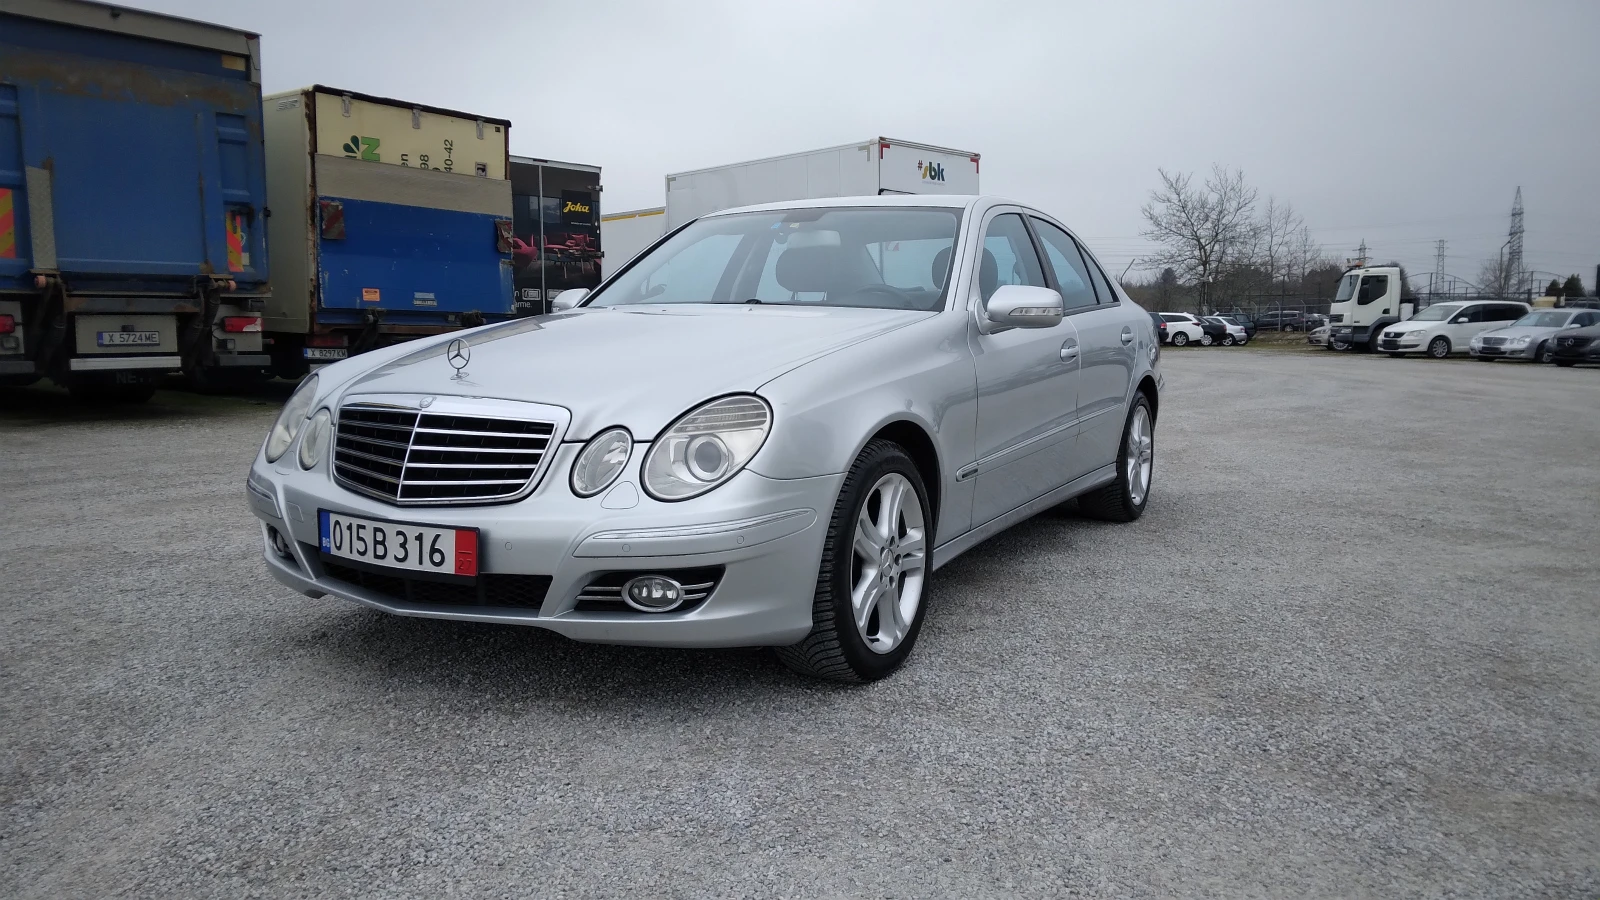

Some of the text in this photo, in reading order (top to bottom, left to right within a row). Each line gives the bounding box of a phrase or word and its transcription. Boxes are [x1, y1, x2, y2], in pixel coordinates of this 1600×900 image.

[917, 160, 945, 181] #sbk
[563, 201, 590, 213] Joka
[119, 333, 143, 343] 5724
[458, 558, 472, 571] 27
